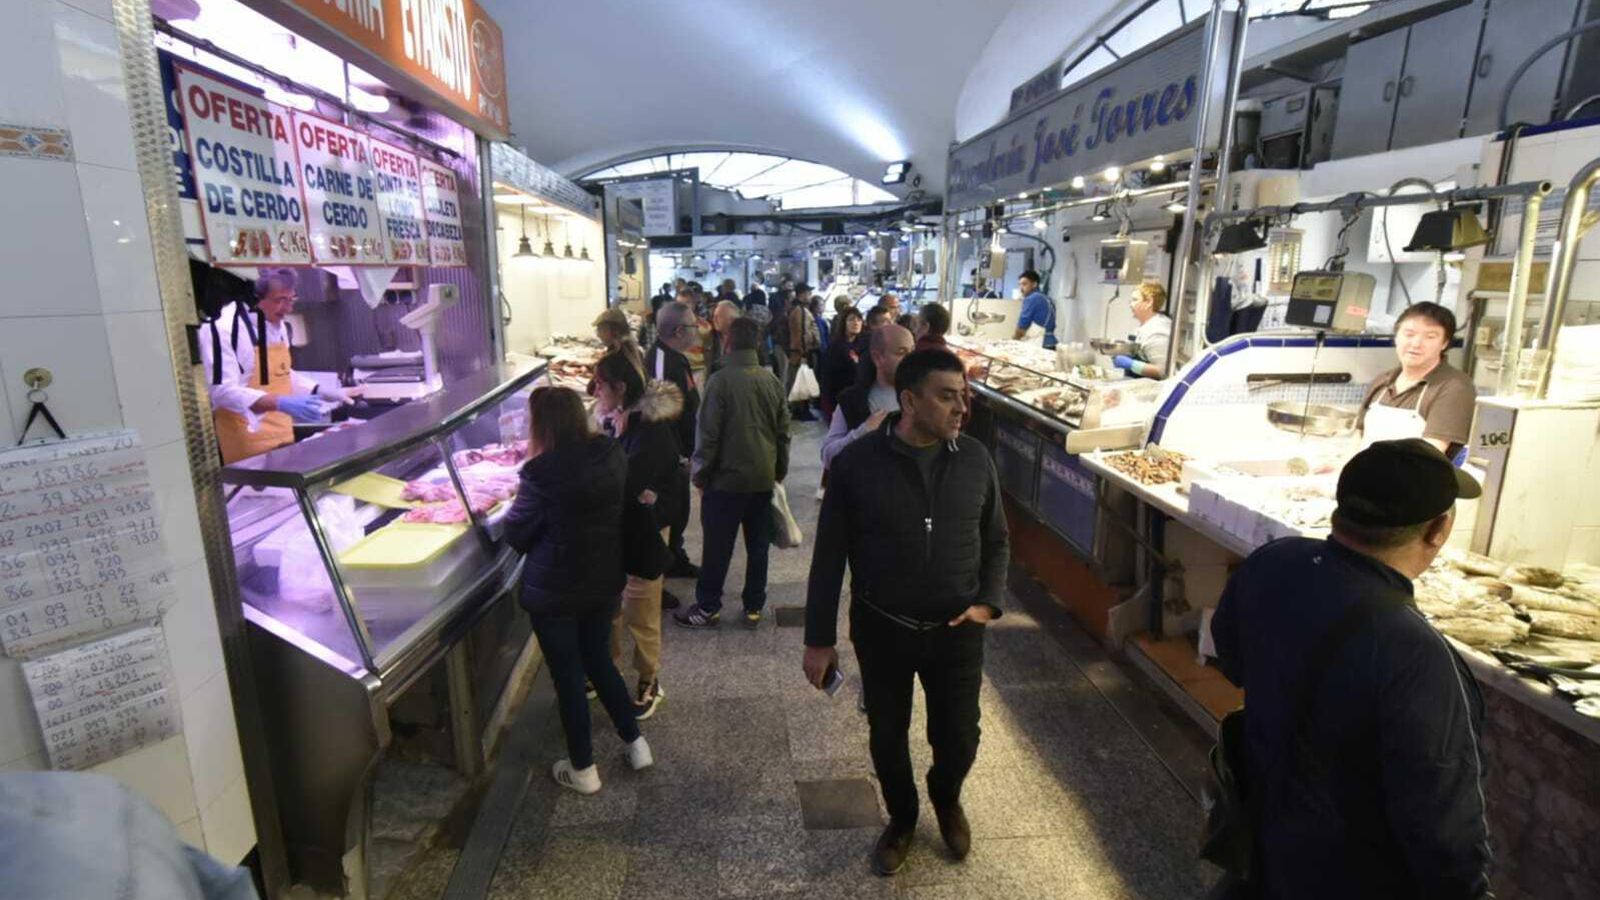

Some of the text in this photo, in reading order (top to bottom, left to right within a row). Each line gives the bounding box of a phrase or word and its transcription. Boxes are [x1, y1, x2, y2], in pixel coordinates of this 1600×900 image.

[189, 84, 289, 144] OFERTA
[1028, 102, 1083, 184] José
[1085, 74, 1198, 151] Torres
[300, 121, 369, 165] OFERTA
[196, 137, 296, 188] COSTILLA
[373, 147, 417, 179] OFERTA
[305, 163, 374, 200] CARNE DE
[204, 182, 301, 223] DE CERDO
[323, 201, 368, 229] CERDO
[386, 218, 421, 240] FRESCA
[1480, 431, 1508, 446] 10€
[4, 582, 33, 601] 86
